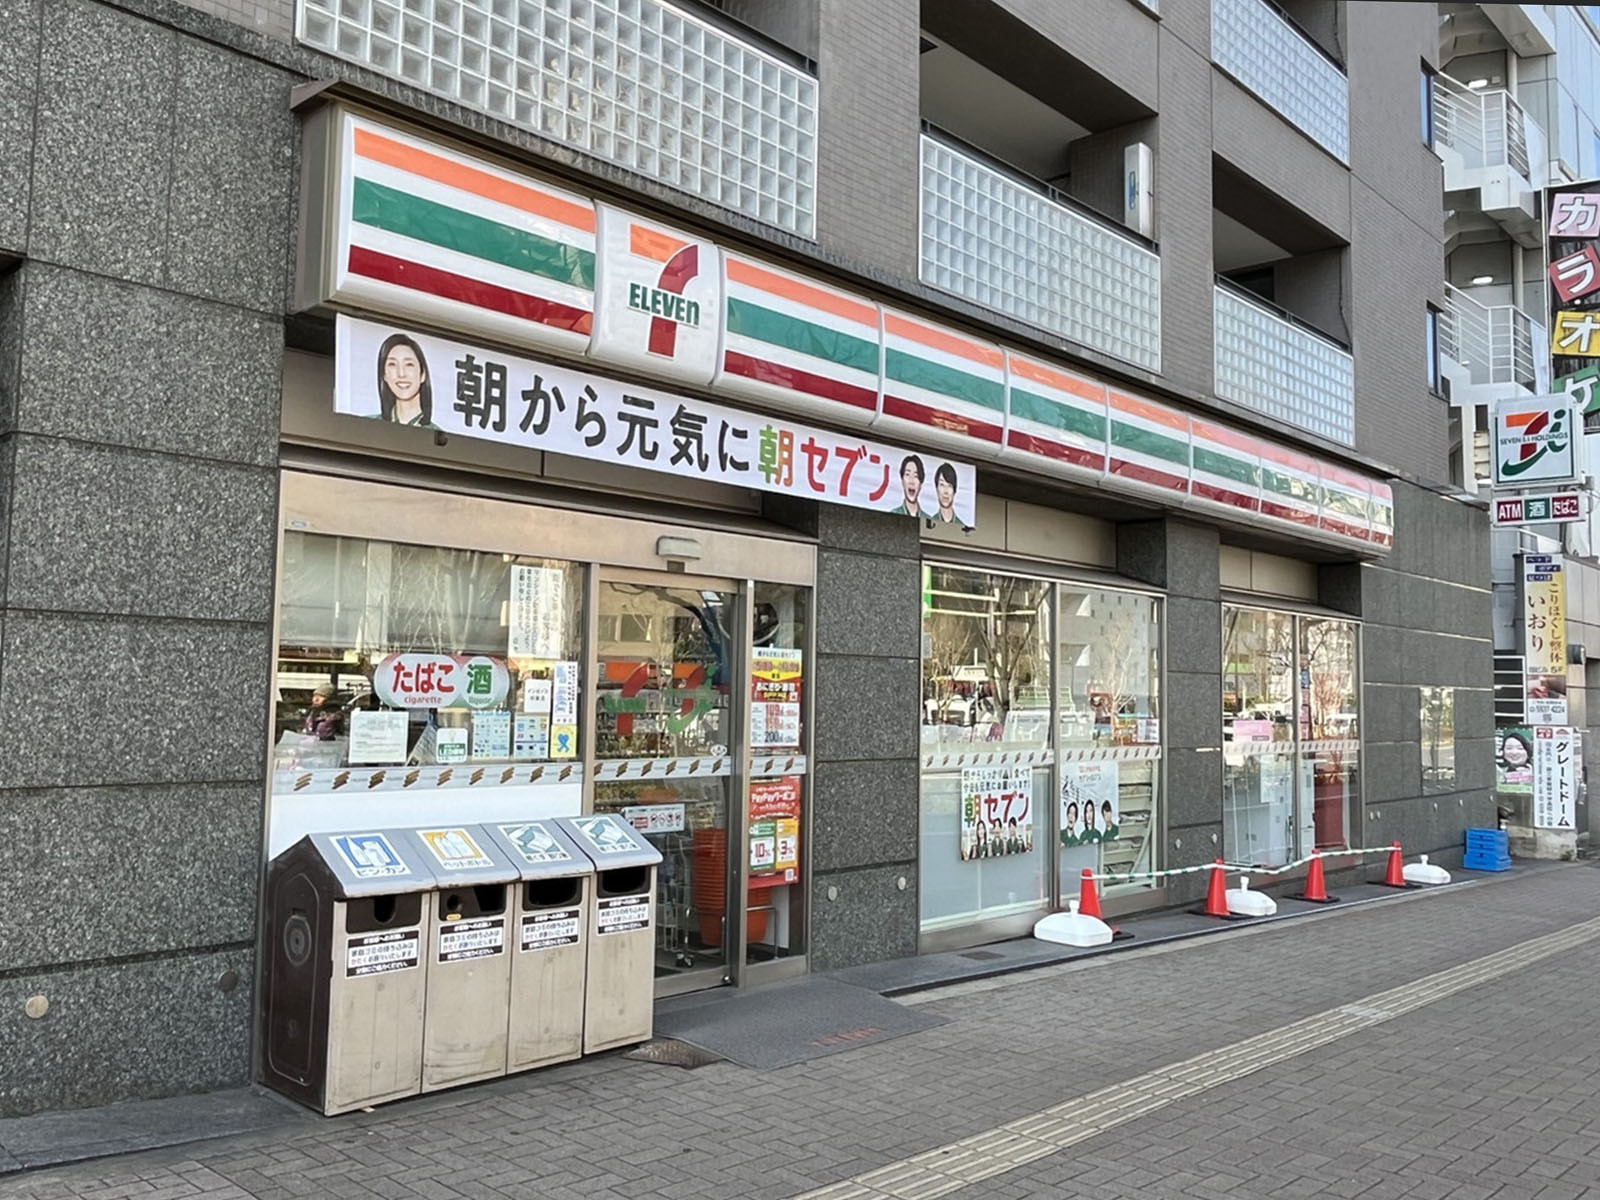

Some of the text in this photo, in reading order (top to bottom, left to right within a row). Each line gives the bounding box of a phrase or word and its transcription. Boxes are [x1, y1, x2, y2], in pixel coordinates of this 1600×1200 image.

[453, 353, 892, 503] 朝から元気に朝セブン
[1498, 502, 1522, 519] ATM
[1528, 501, 1545, 517] 酒
[1553, 499, 1578, 515] たばこ
[1527, 595, 1547, 652] いおり
[392, 661, 493, 695] たばこ 酒
[1556, 741, 1570, 827] グレートドーム
[964, 791, 1030, 828] 朝セブン
